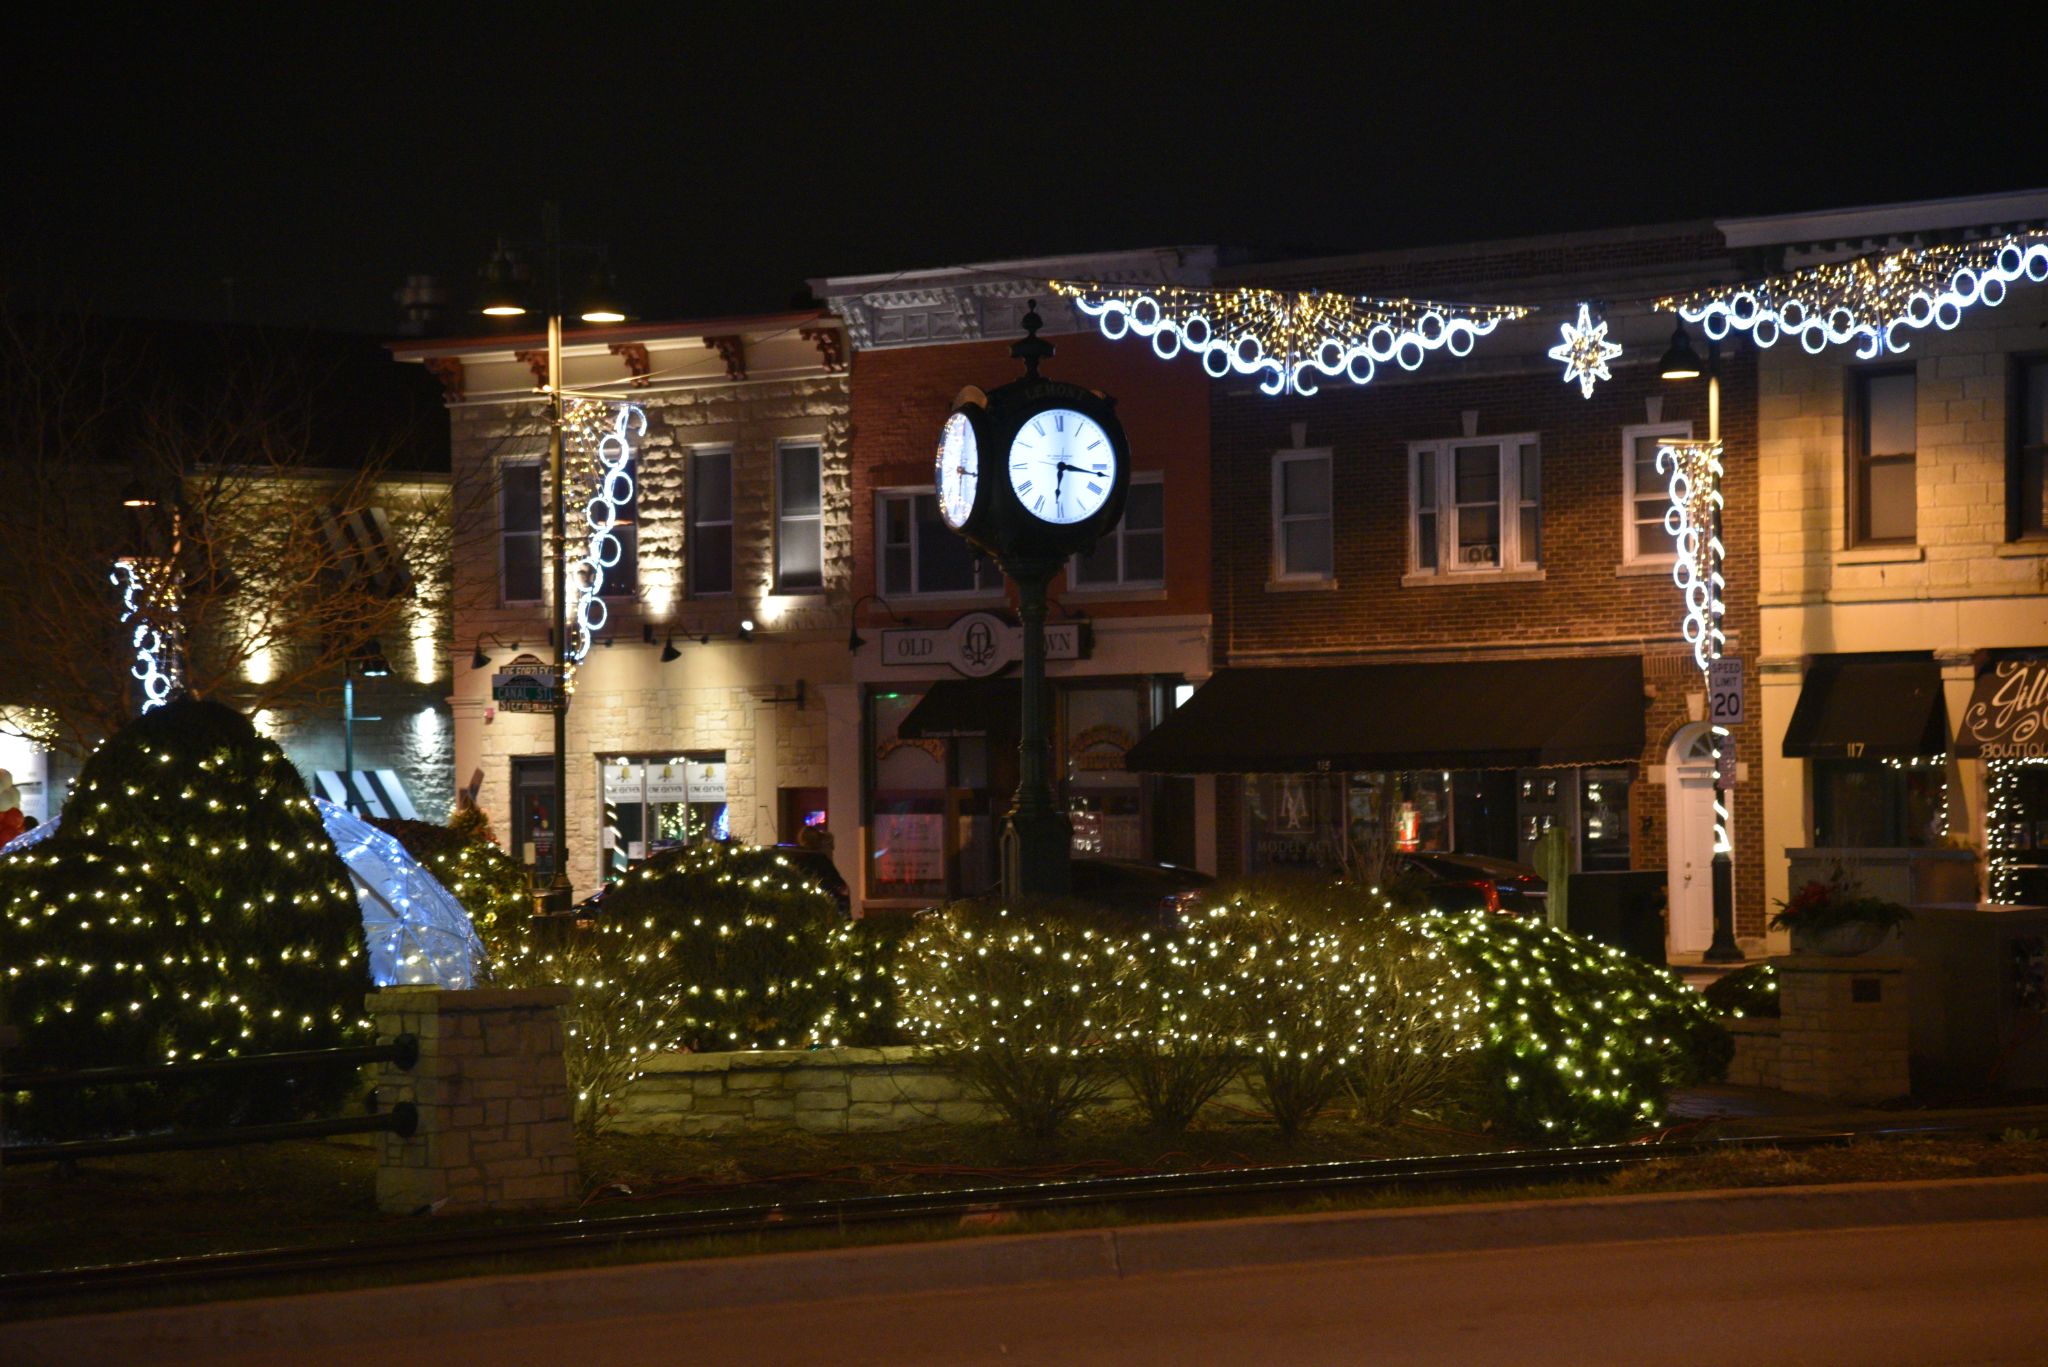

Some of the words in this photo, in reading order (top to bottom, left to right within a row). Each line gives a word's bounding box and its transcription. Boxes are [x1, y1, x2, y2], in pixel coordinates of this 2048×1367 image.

[898, 638, 933, 657] OLD
[1712, 663, 1740, 674] SPEED
[1715, 677, 1738, 687] LIMIT
[497, 687, 529, 699] CANAL
[1714, 692, 1740, 717] 20
[1846, 742, 1865, 759] 117
